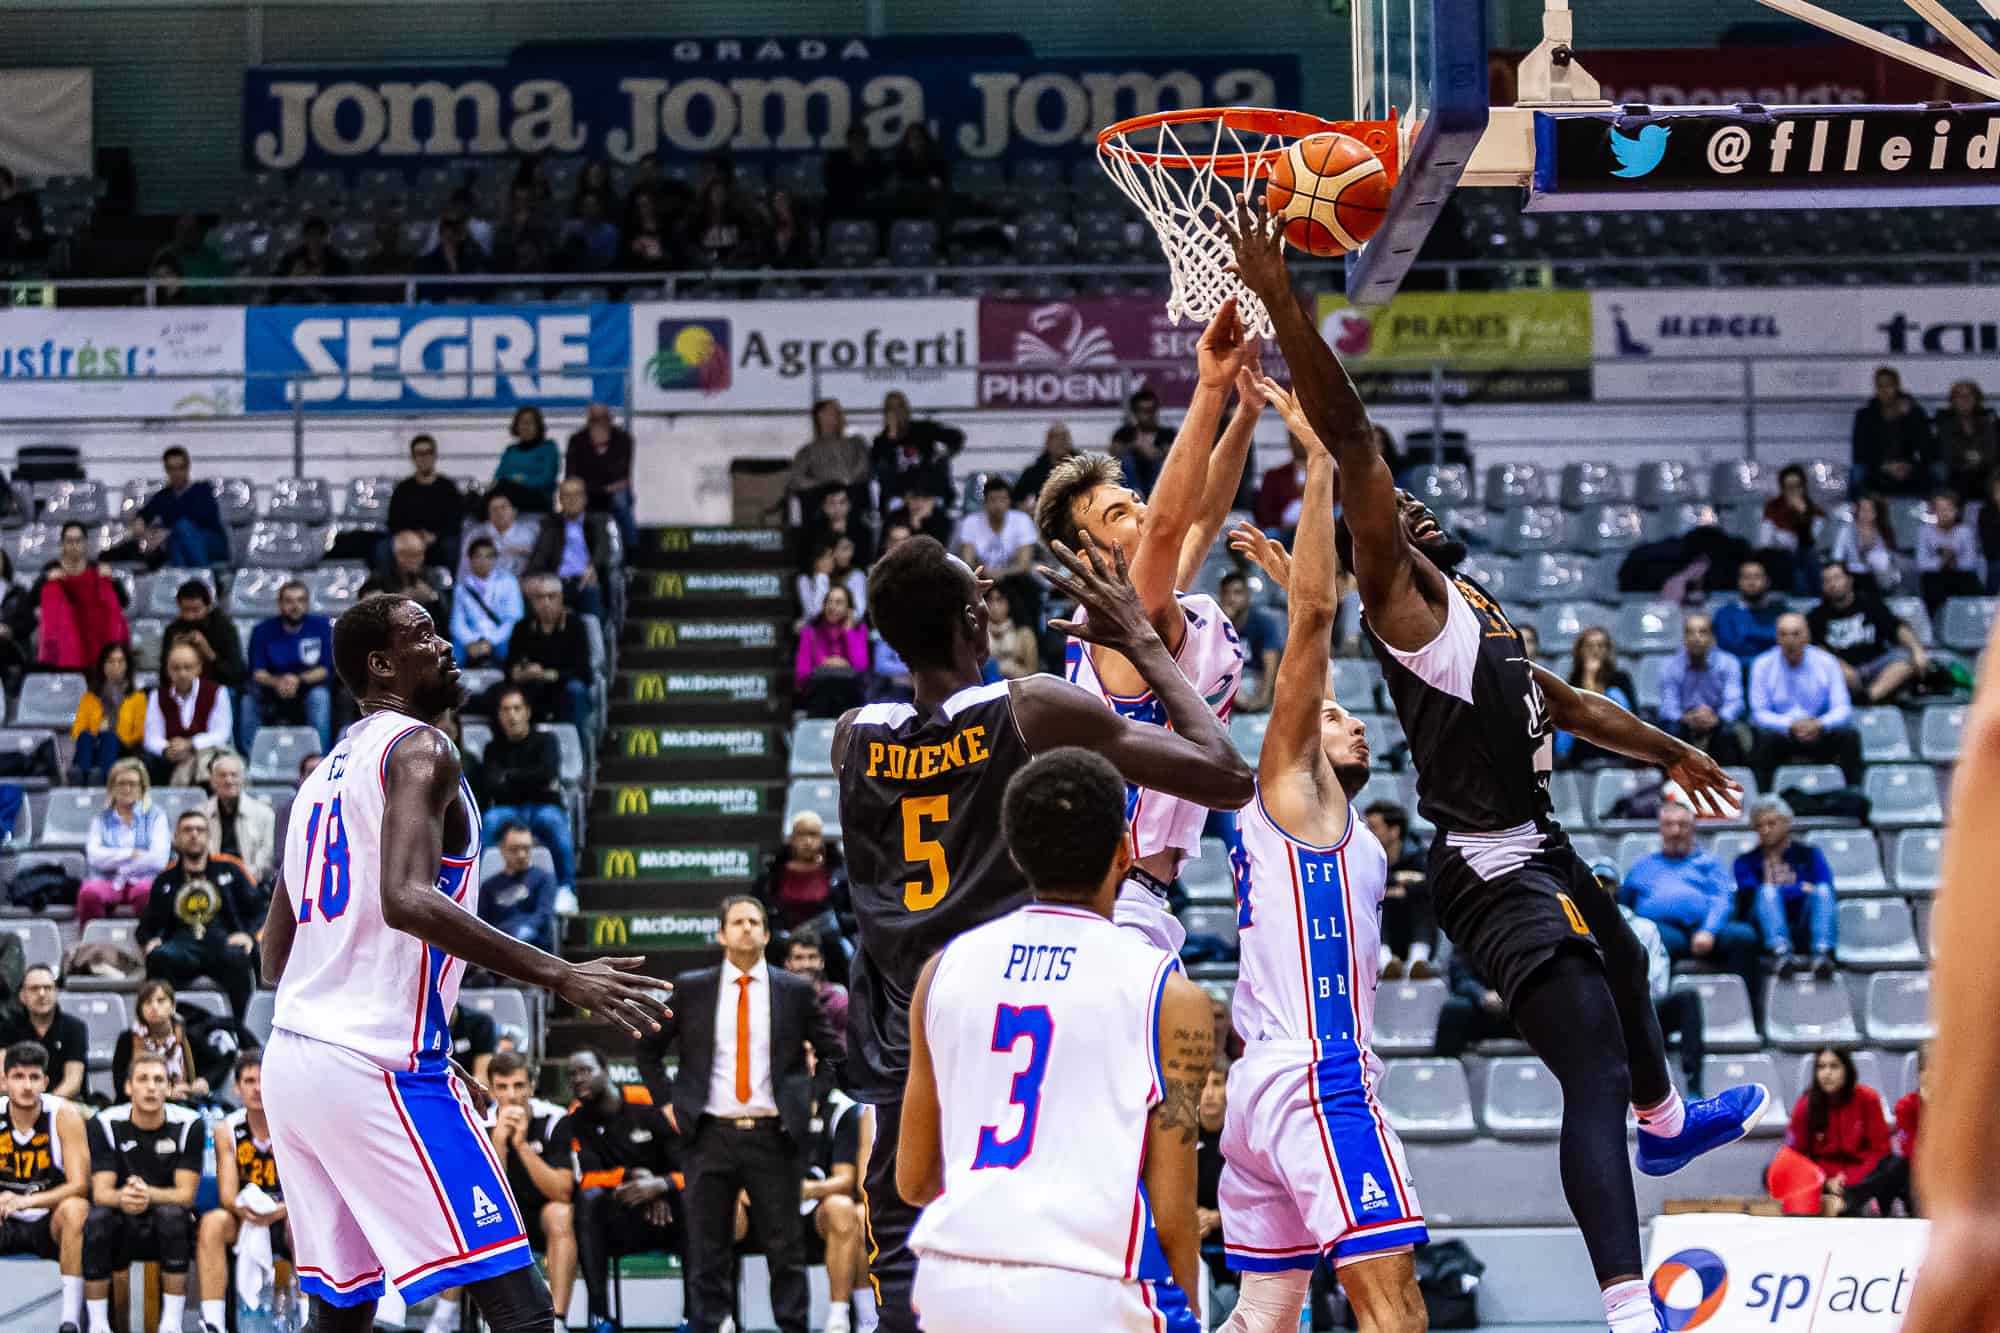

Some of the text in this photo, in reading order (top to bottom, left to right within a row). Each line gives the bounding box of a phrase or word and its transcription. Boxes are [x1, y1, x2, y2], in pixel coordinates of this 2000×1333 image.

[673, 40, 870, 60] GRADA
[255, 79, 588, 168] Joma
[606, 75, 940, 163] Joma
[1706, 117, 2000, 174] @flleid
[287, 315, 593, 400] SEGRE
[740, 326, 967, 377] Agroferti
[866, 725, 990, 780] P.DIENE
[652, 788, 757, 805] McDonald's
[639, 850, 750, 868] McDonald's
[901, 794, 949, 912] 5
[1003, 943, 1077, 981] PITTS
[970, 1003, 1055, 1170] 3
[14, 1151, 35, 1178] 17
[1745, 1267, 1909, 1323] sp act
